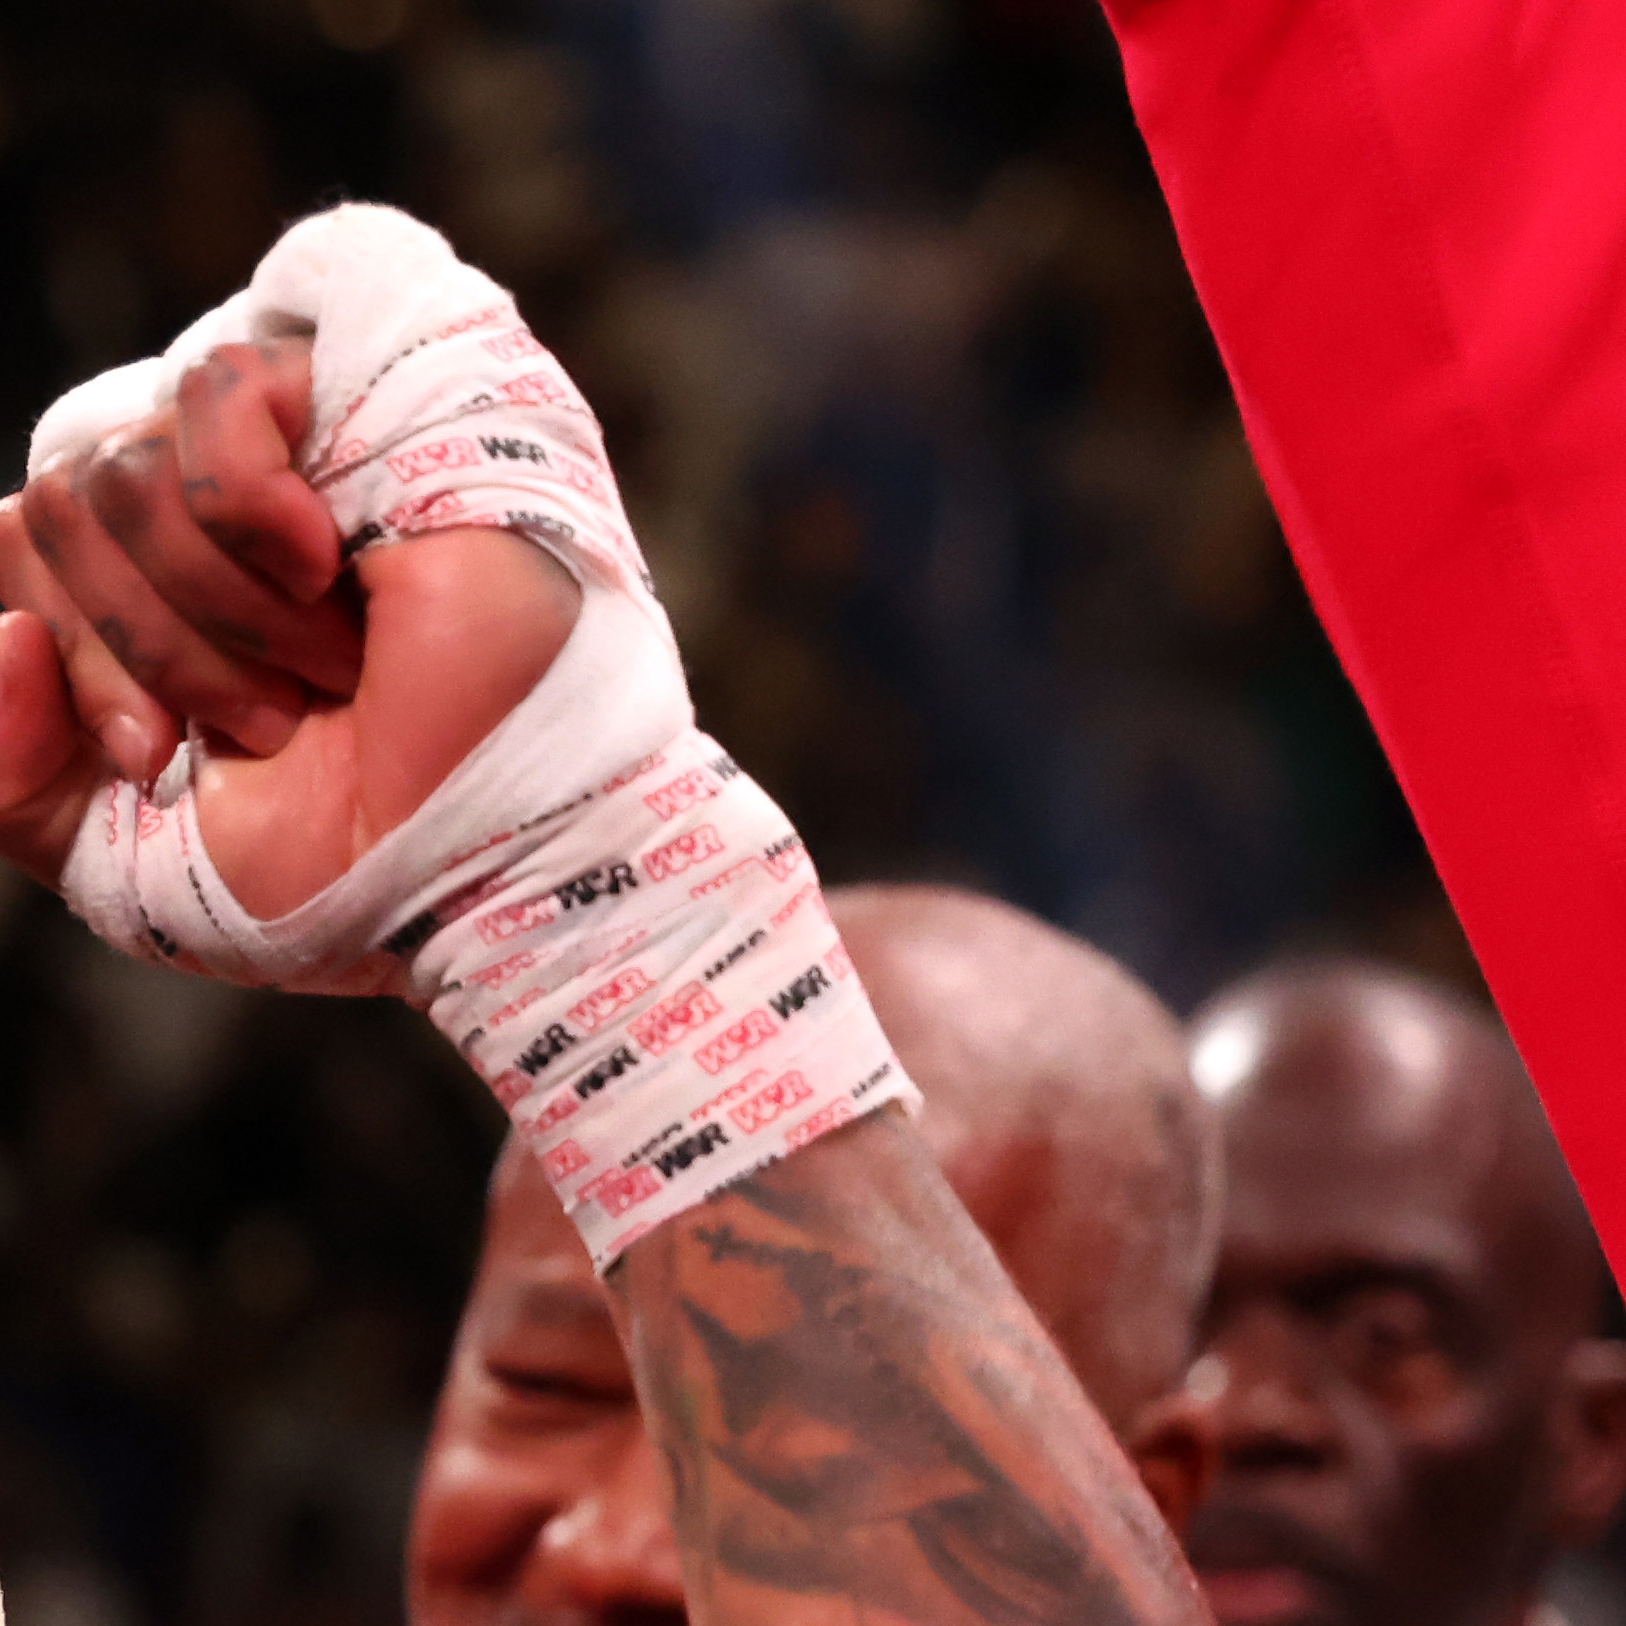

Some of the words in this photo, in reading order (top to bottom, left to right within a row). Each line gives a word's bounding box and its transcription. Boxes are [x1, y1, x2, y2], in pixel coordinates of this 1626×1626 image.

[640, 823, 726, 883] WAR
[514, 1021, 577, 1077] WAR
[565, 966, 658, 1035] WAR
[693, 1008, 779, 1077] WAR
[768, 963, 832, 1021] WAR
[653, 1121, 731, 1180] WAR
[726, 1069, 815, 1136] WAR
